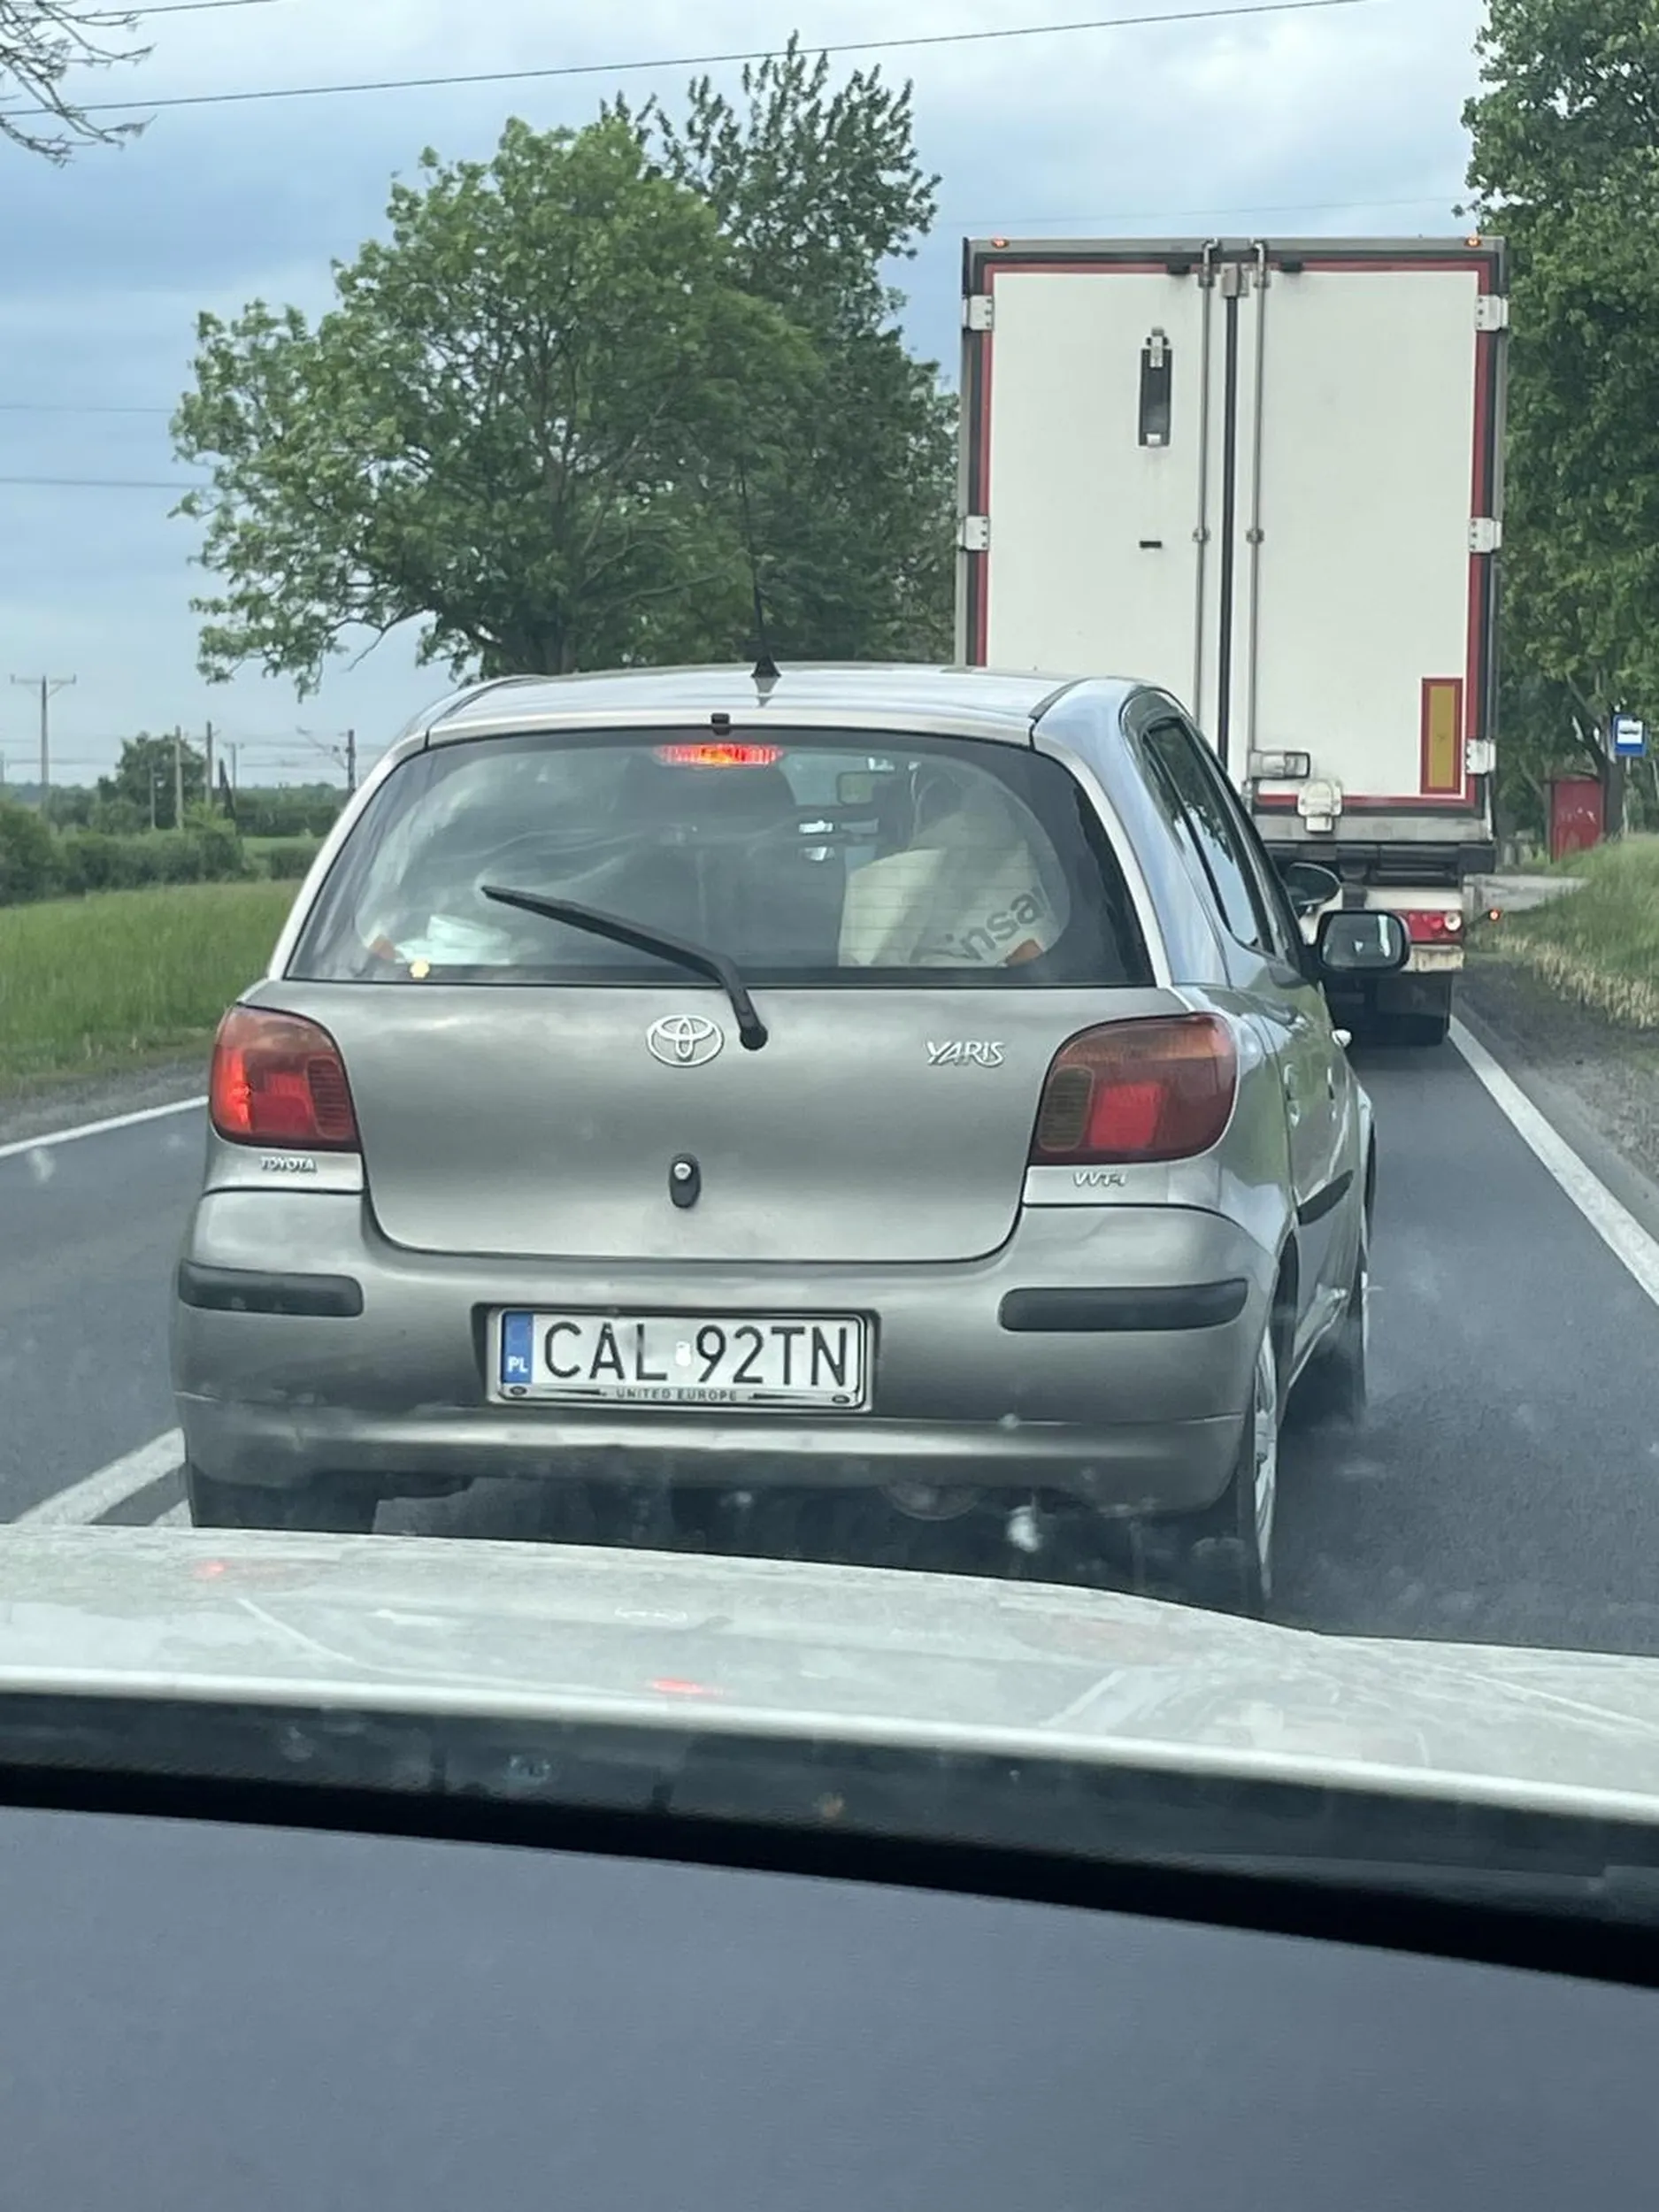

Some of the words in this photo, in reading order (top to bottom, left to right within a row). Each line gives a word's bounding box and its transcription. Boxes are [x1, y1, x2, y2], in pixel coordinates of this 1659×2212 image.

[260, 1155, 317, 1173] TOYOTA
[543, 1321, 668, 1382] CAL
[695, 1325, 848, 1387] 92TN
[507, 1355, 529, 1374] PL
[615, 1387, 671, 1400] UNITED
[676, 1388, 737, 1402] EUROPE
